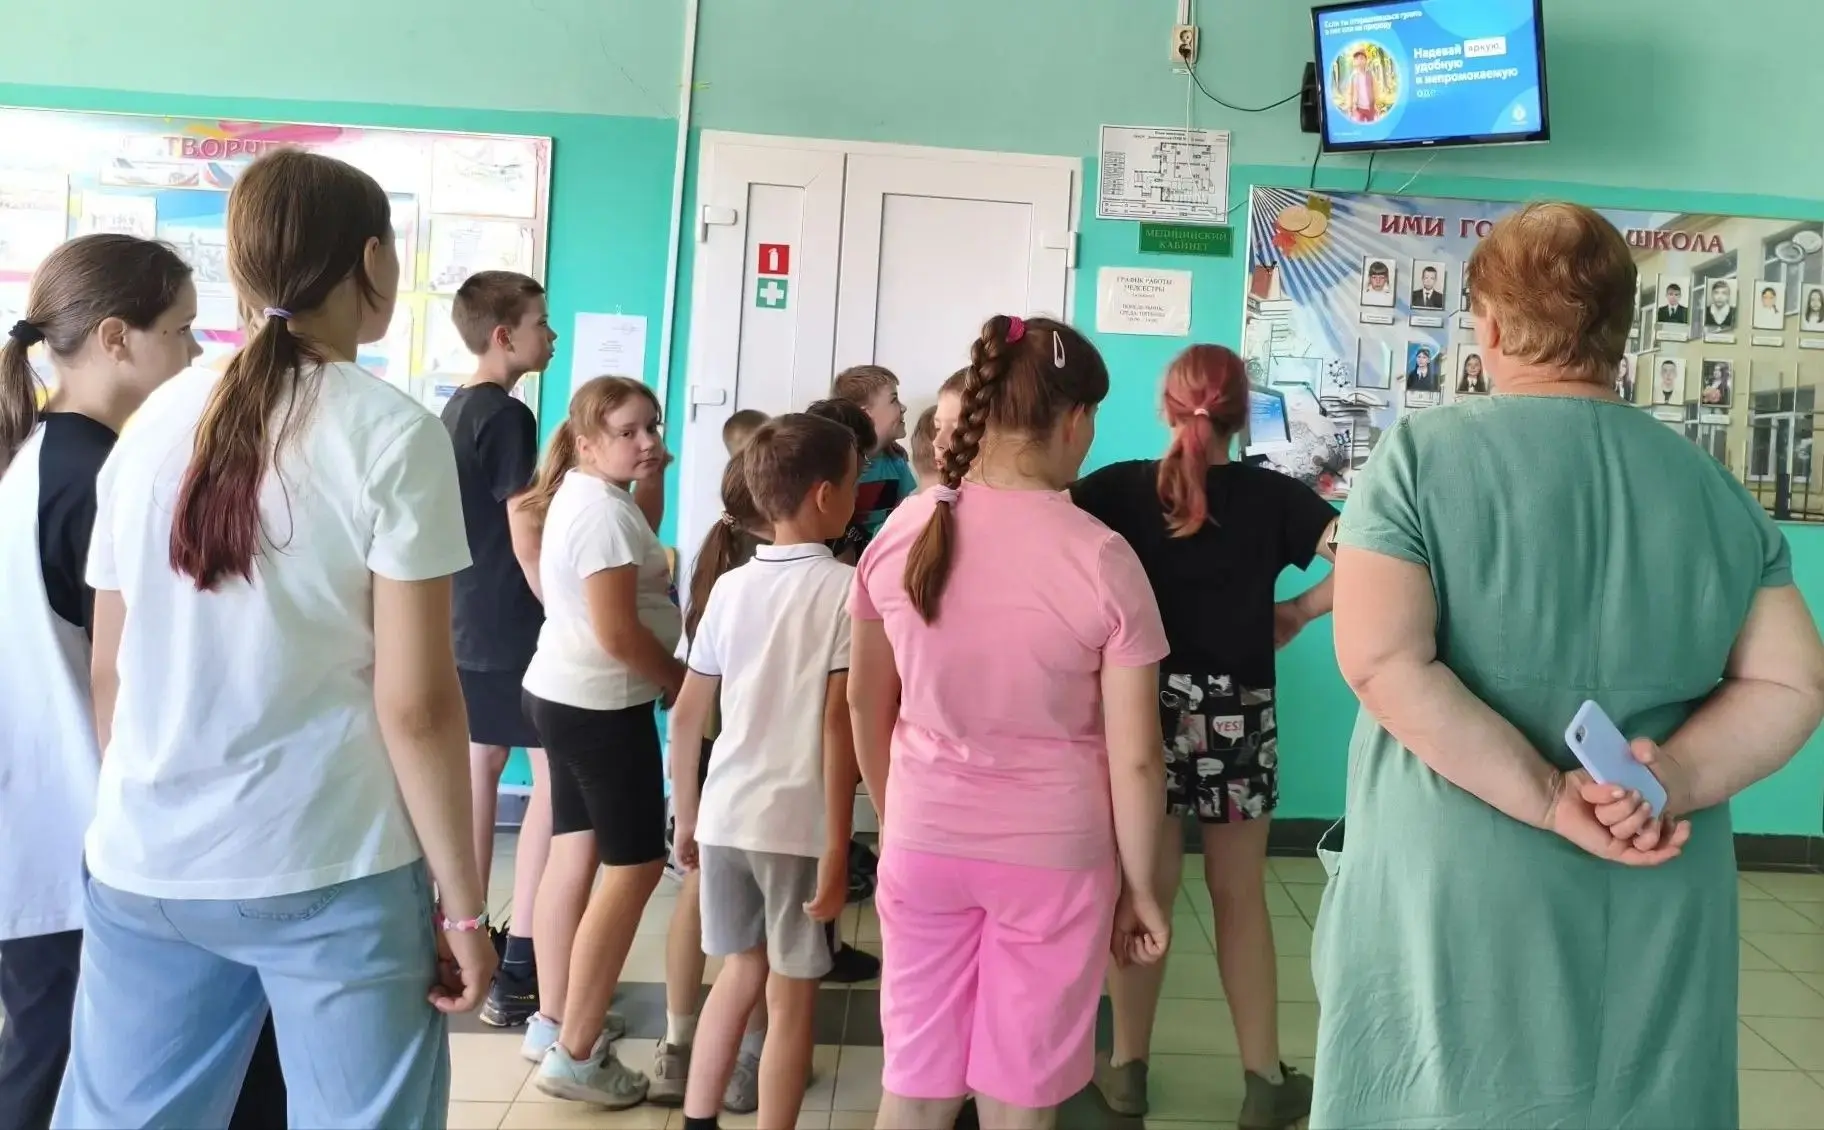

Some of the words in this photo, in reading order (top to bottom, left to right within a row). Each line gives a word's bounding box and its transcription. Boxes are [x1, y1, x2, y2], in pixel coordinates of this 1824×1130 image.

[1413, 43, 1462, 59] Надевай
[1414, 59, 1464, 75] удобную
[1424, 67, 1519, 85] непромокаемую
[1380, 213, 1445, 237] ИМИ
[1159, 241, 1209, 251] КАБИНЕТ
[1625, 228, 1725, 253] ШКОЛА
